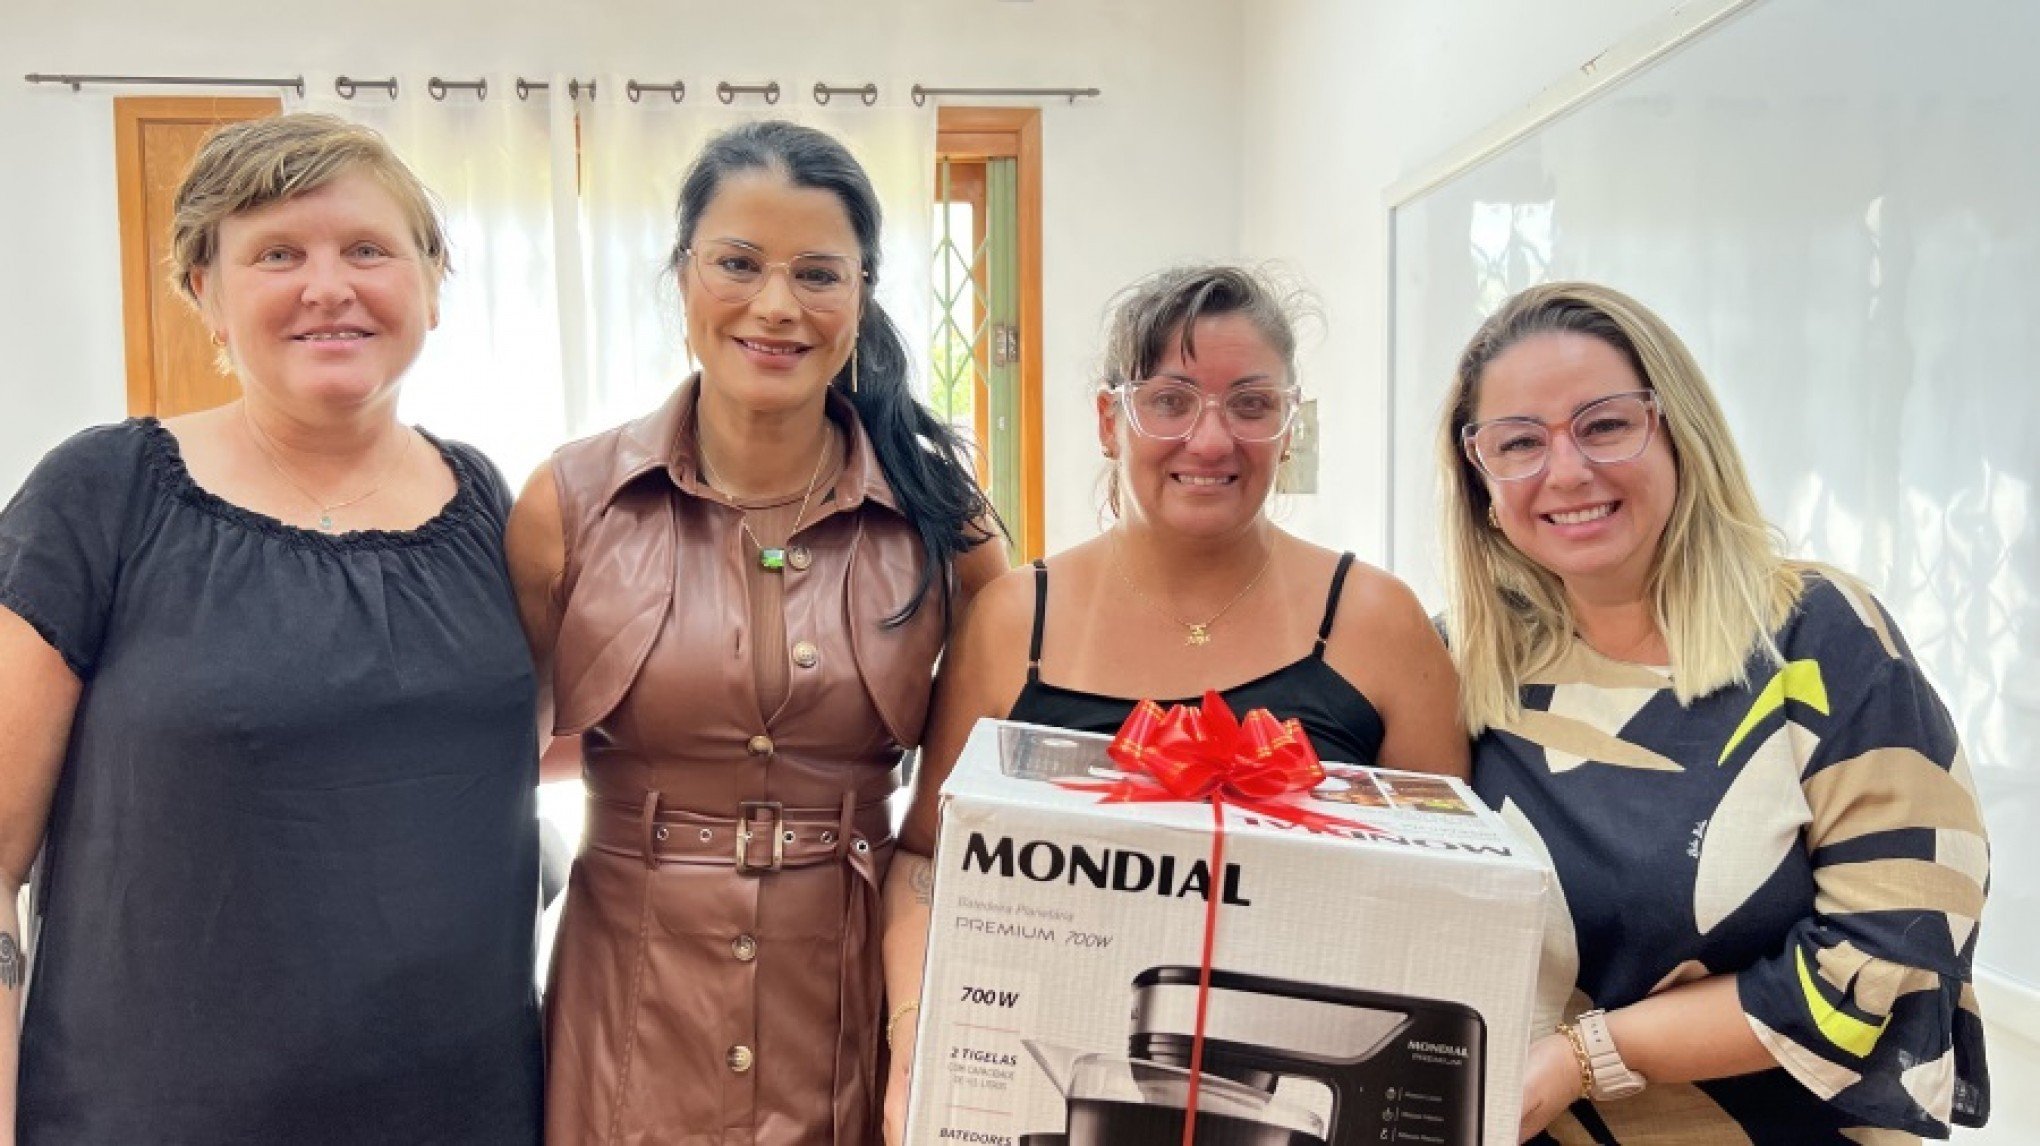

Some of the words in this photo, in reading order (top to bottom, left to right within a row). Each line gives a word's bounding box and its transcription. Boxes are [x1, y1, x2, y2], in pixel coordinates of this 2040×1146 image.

[961, 832, 1252, 906] MONDIAL
[955, 916, 1055, 941] PREMIUM
[1064, 930, 1114, 948] 700W
[951, 1046, 960, 1059] 2
[962, 1048, 1018, 1066] TIGELAS
[940, 1128, 1012, 1146] BATEDORES
